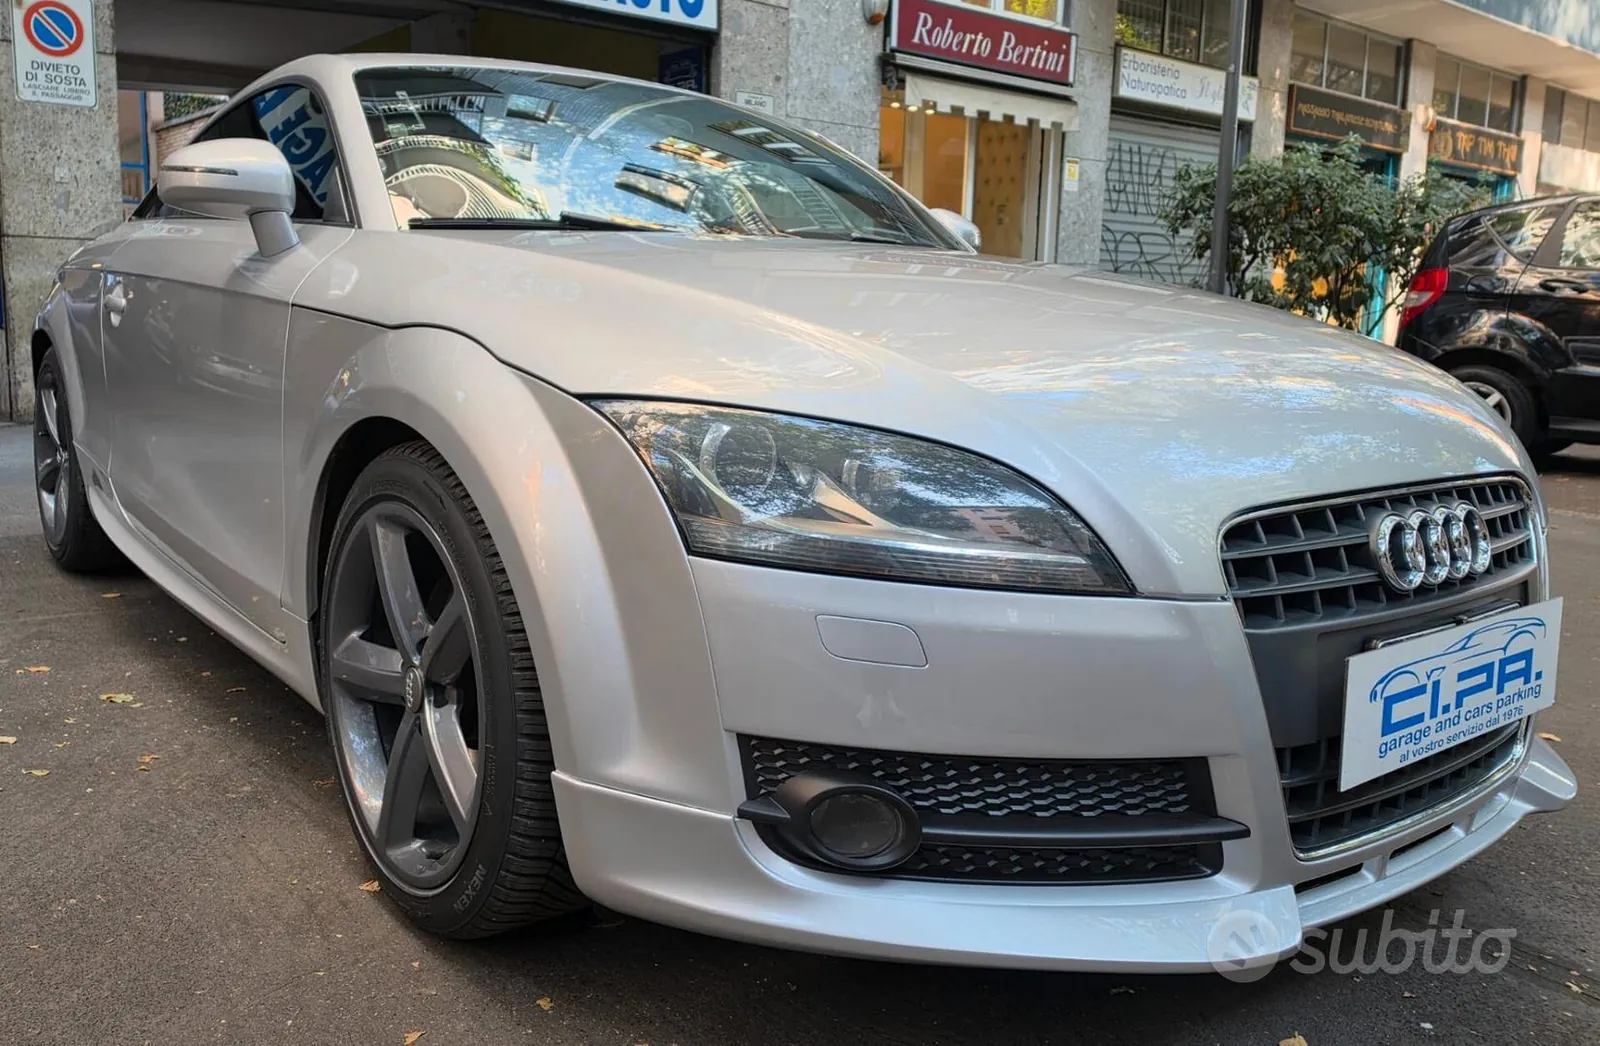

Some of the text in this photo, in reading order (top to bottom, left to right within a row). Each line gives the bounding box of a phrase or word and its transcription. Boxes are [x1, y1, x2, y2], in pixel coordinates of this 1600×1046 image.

[913, 11, 1067, 73] Roberto Bertini
[25, 71, 87, 88] DI SOSTA
[30, 60, 80, 76] DIVIETO
[1121, 53, 1181, 80] Erboristeria
[1121, 73, 1187, 99] Naturopatica
[1378, 682, 1542, 759] garage and cars parking
[1399, 705, 1524, 763] al vostro servizio dal 1976
[453, 863, 487, 913] NEXEN
